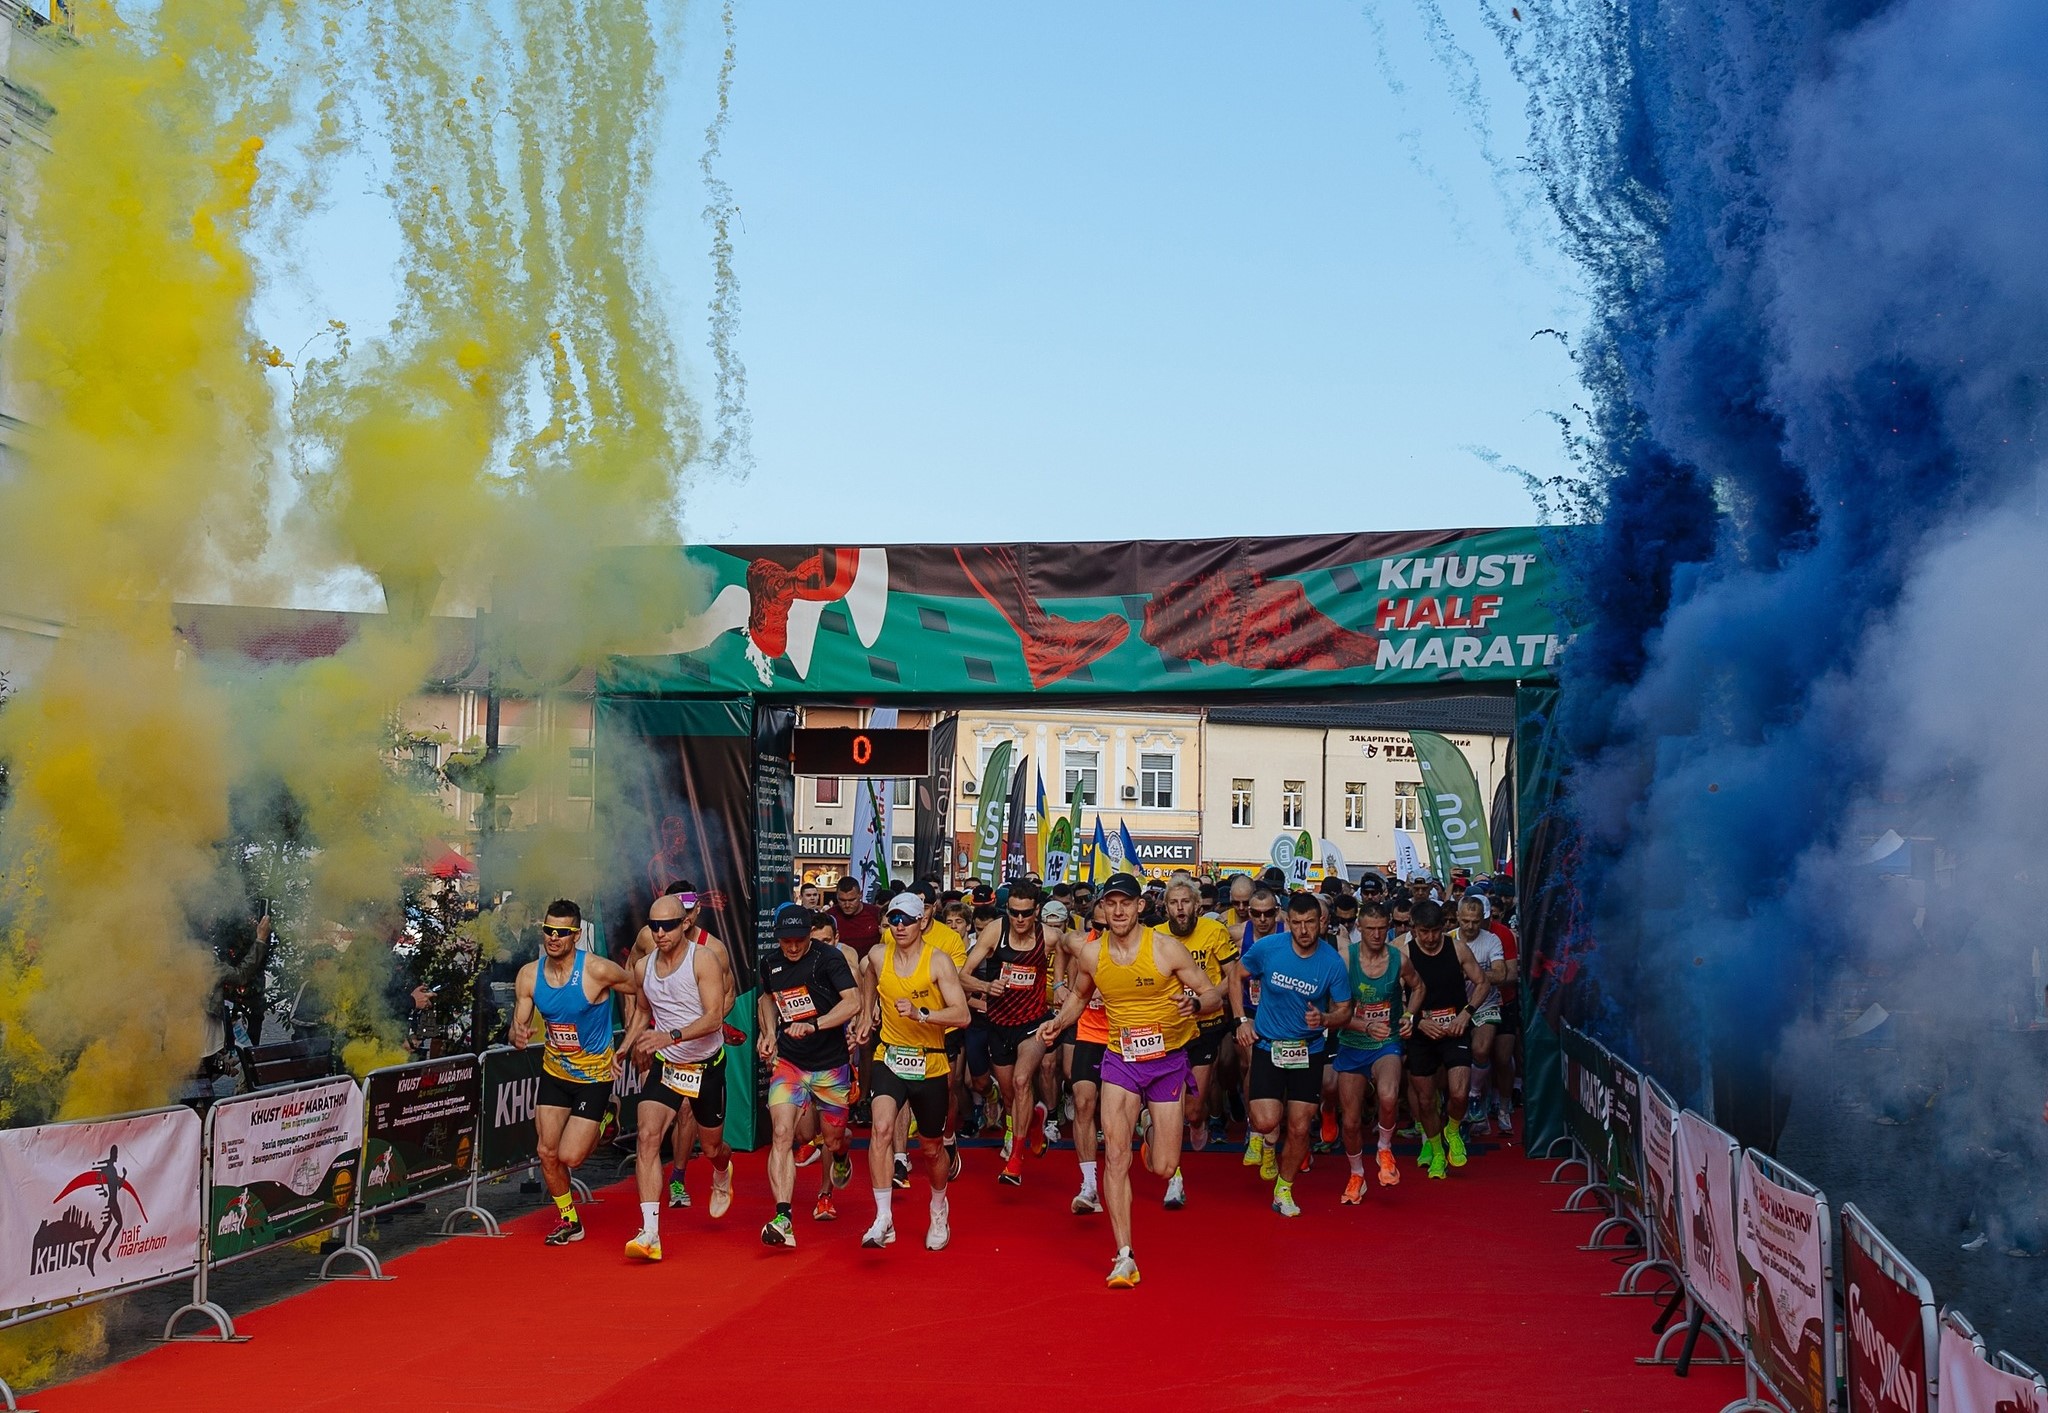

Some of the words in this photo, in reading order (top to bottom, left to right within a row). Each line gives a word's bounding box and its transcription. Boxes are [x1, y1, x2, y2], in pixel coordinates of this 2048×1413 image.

[1378, 554, 1536, 590] KHUST
[1375, 594, 1503, 631] HALF
[853, 735, 872, 764] 0
[782, 917, 803, 925] HOKA
[1271, 971, 1318, 994] saucony
[1295, 986, 1310, 996] TEAM
[787, 996, 811, 1009] 1059
[1365, 1010, 1389, 1018] 1041
[554, 1032, 578, 1042] 1138
[1133, 1035, 1162, 1049] 1087
[1282, 1049, 1307, 1058] 2045
[896, 1056, 925, 1068] 2007
[397, 1076, 421, 1093] KHUST
[437, 1067, 473, 1085] MARATHON
[674, 1072, 700, 1084] 4001
[251, 1107, 281, 1126] KHUST
[281, 1101, 305, 1119] HALF
[304, 1092, 349, 1114] MARATHON
[120, 1225, 141, 1244] half
[117, 1235, 167, 1258] marathon
[35, 1238, 96, 1275] KHUST
